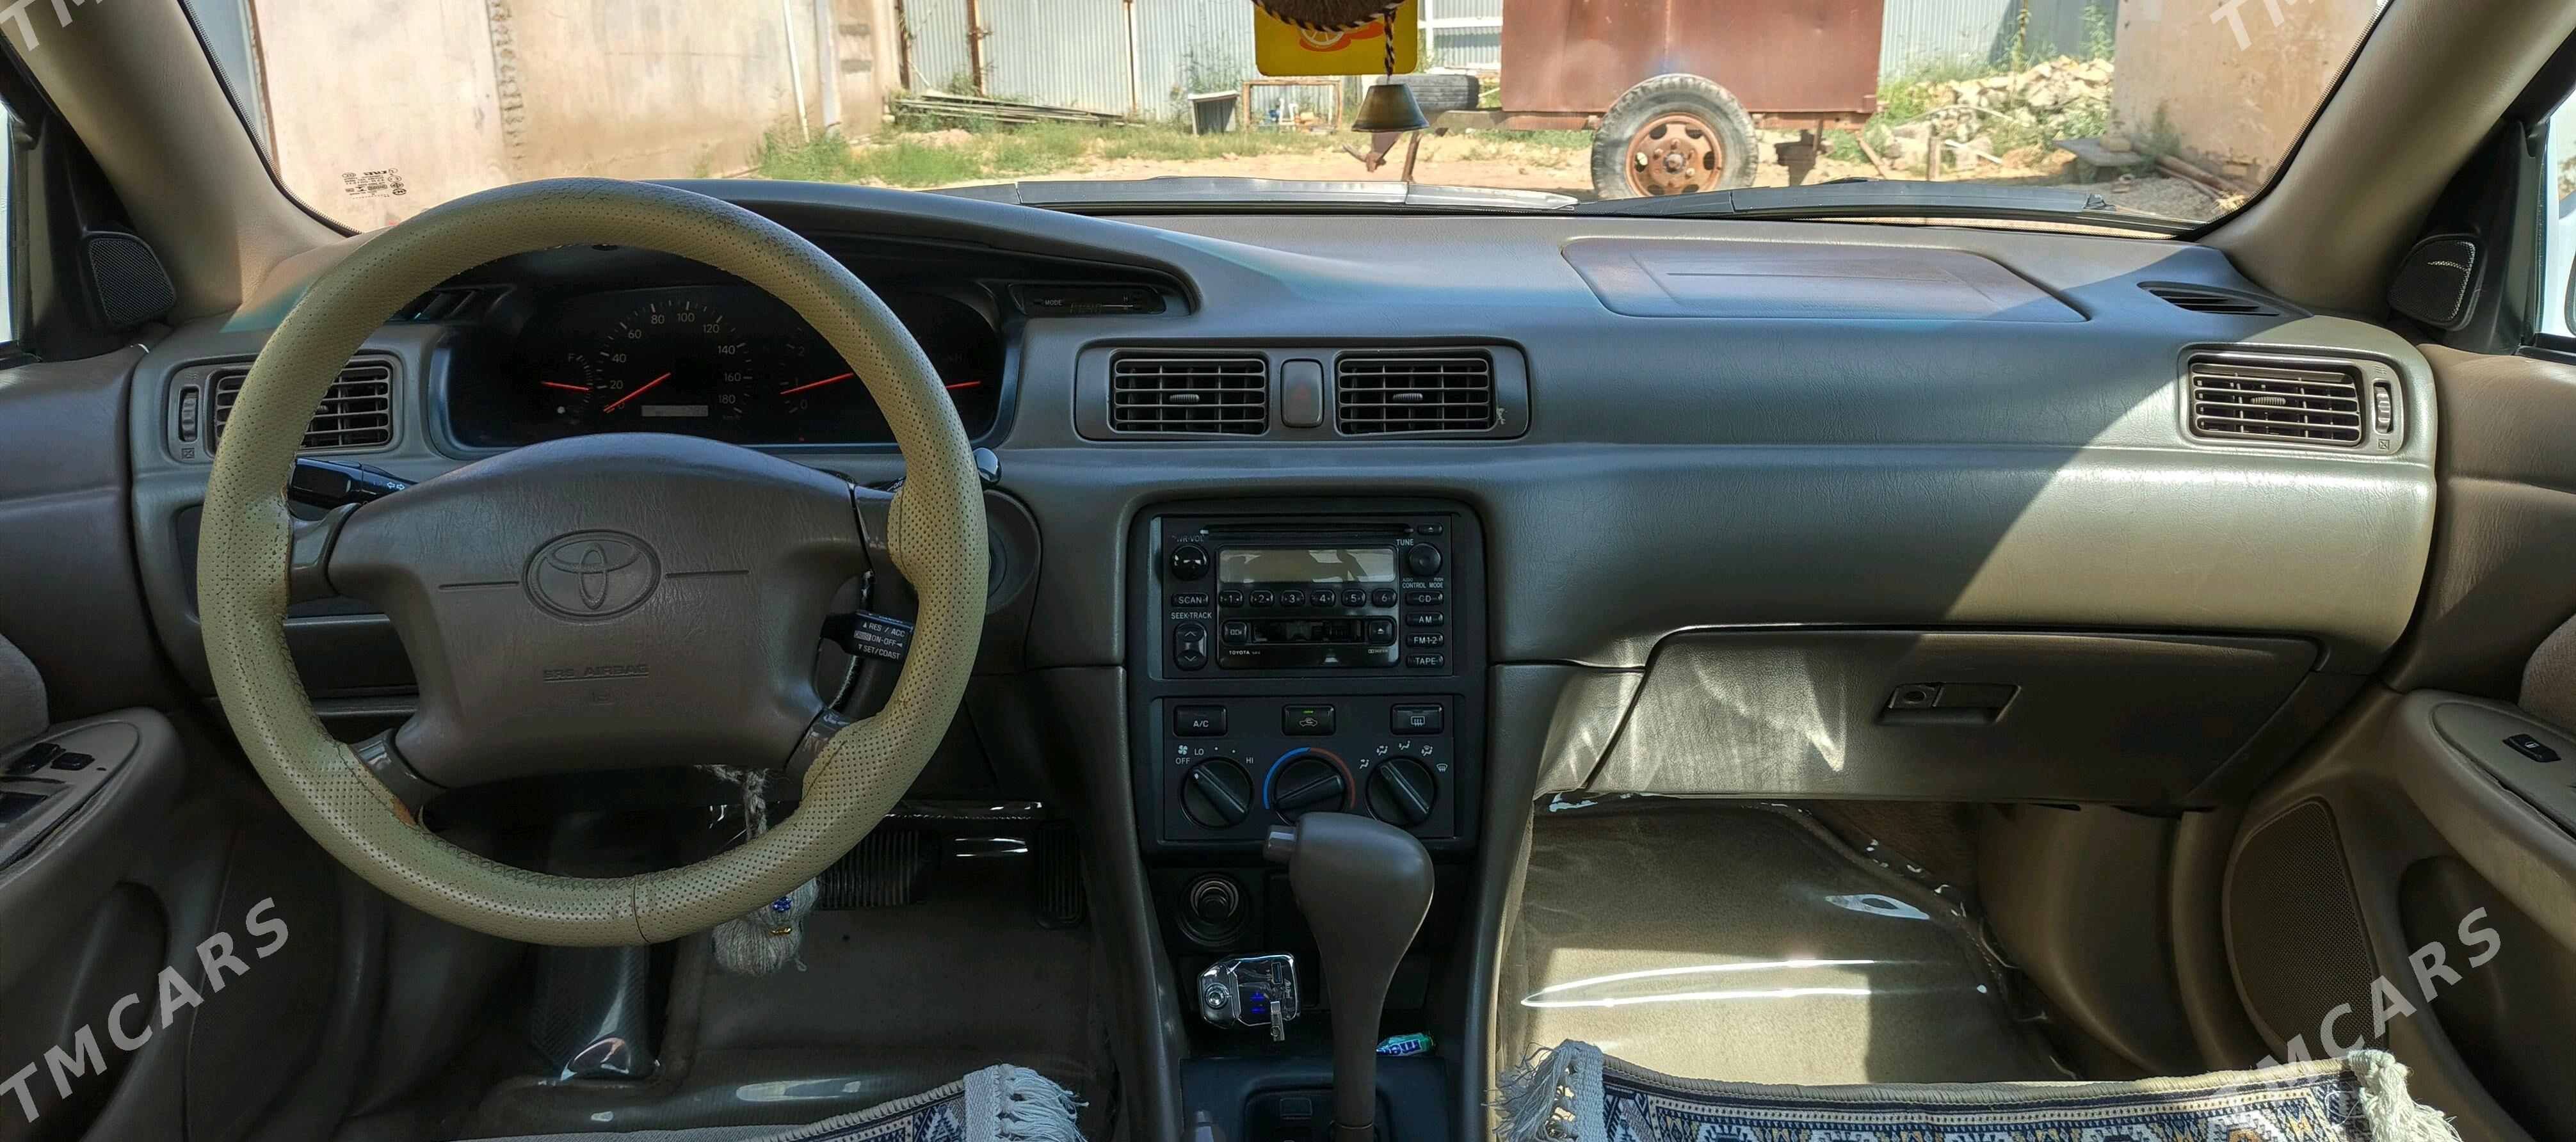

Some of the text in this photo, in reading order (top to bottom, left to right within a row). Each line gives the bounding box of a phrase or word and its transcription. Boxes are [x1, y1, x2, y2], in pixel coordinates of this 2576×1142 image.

[651, 315, 665, 325] 80
[678, 313, 695, 322] 100
[704, 325, 720, 334] 120
[628, 330, 641, 339] 60
[718, 346, 736, 355] 140
[798, 346, 805, 357] 2
[568, 353, 574, 362] F
[612, 353, 627, 363] 40
[724, 373, 741, 382] 160
[609, 380, 624, 389] 20
[719, 395, 736, 404] 180
[800, 399, 808, 410] 0
[1178, 596, 1202, 604] SCAN
[1289, 595, 1296, 603] 3
[1319, 594, 1326, 602] 4
[1351, 594, 1356, 602] 5
[1381, 594, 1388, 602] 6
[869, 622, 882, 632] RES
[890, 628, 905, 638] ACC
[871, 636, 896, 646] ON-OFF
[863, 646, 901, 660] SET/COAST
[543, 664, 648, 678] SRS AIRBAG
